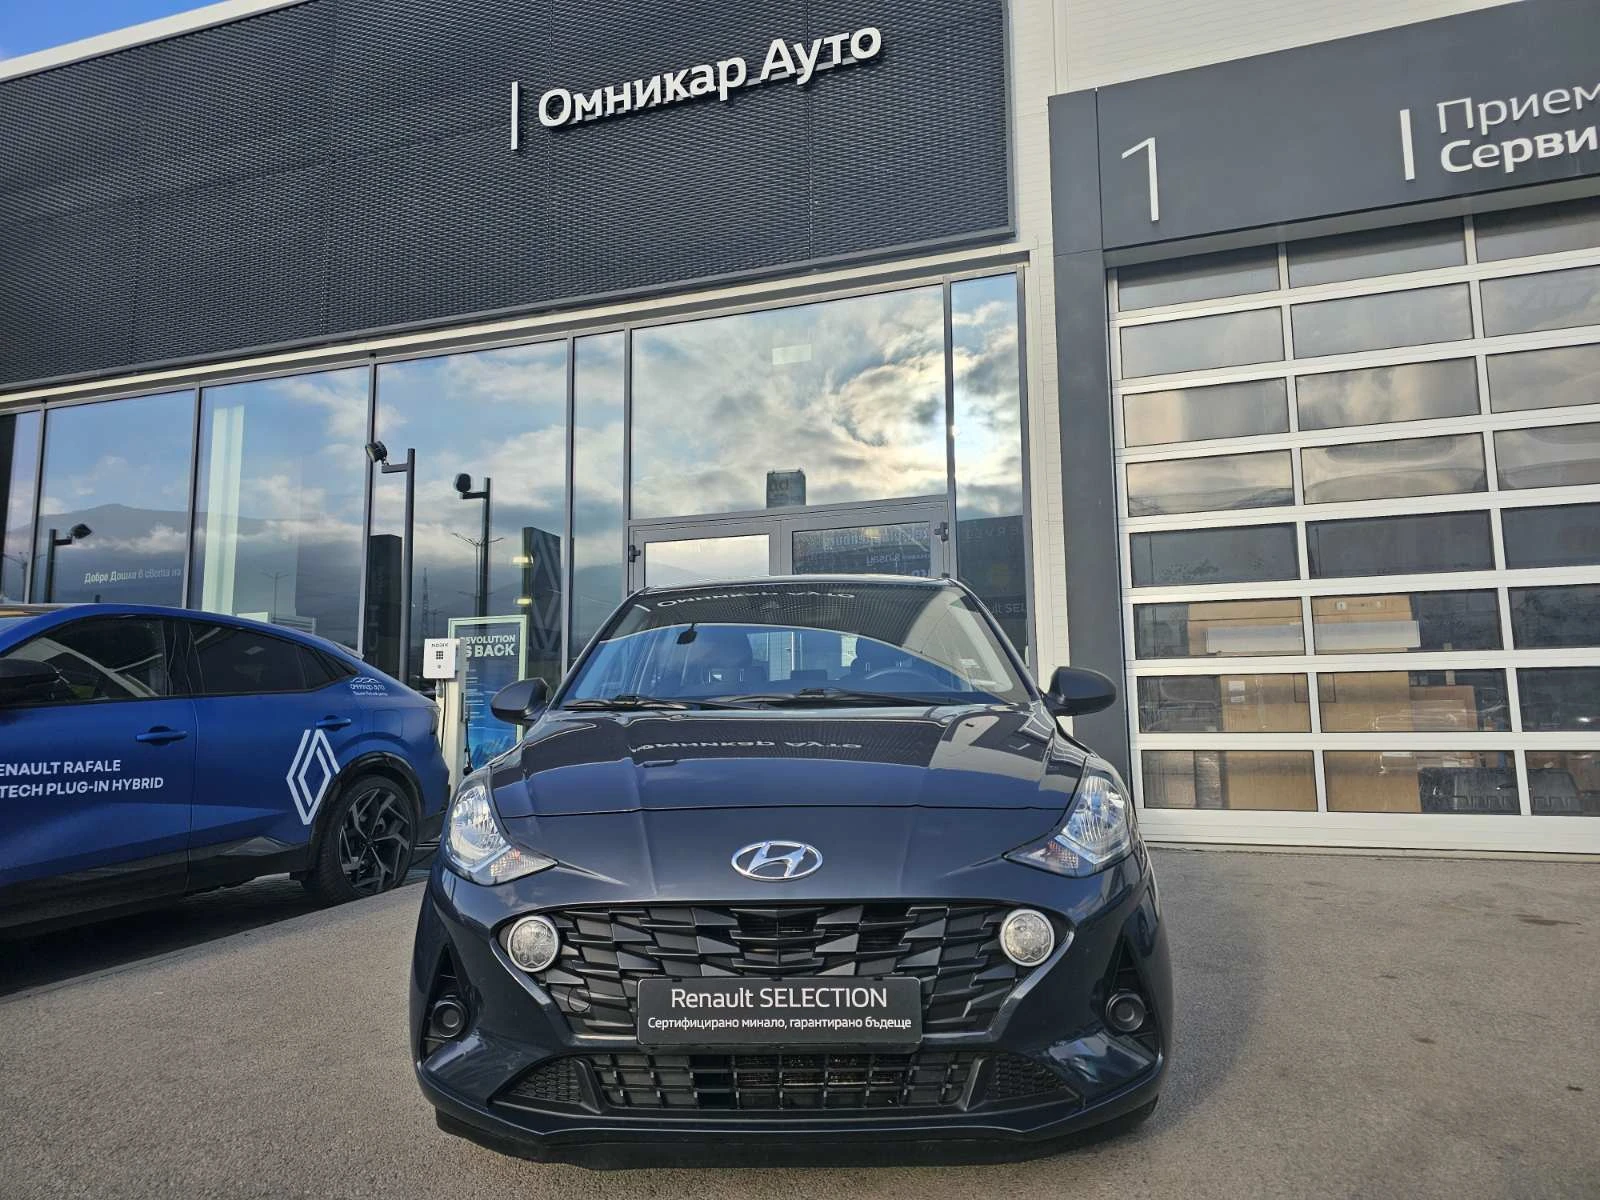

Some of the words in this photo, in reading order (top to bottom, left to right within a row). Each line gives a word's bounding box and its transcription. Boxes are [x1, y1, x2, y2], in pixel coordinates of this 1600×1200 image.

[538, 56, 747, 127] Омникар
[760, 26, 882, 85] Ауто
[1440, 125, 1599, 173] Серви
[1121, 136, 1160, 221] 1
[84, 572, 109, 585] Добре
[474, 643, 515, 657] BACK
[63, 759, 121, 774] RAFALE
[46, 779, 110, 796] PLUG-IN
[112, 776, 164, 791] HYBRID
[670, 987, 754, 1009] Renault
[759, 986, 888, 1009] SELECTION
[647, 1016, 740, 1031] Сертифицирано
[741, 1018, 788, 1030] минало,
[789, 1018, 864, 1031] гарантирано
[865, 1016, 912, 1031] бъдеще
